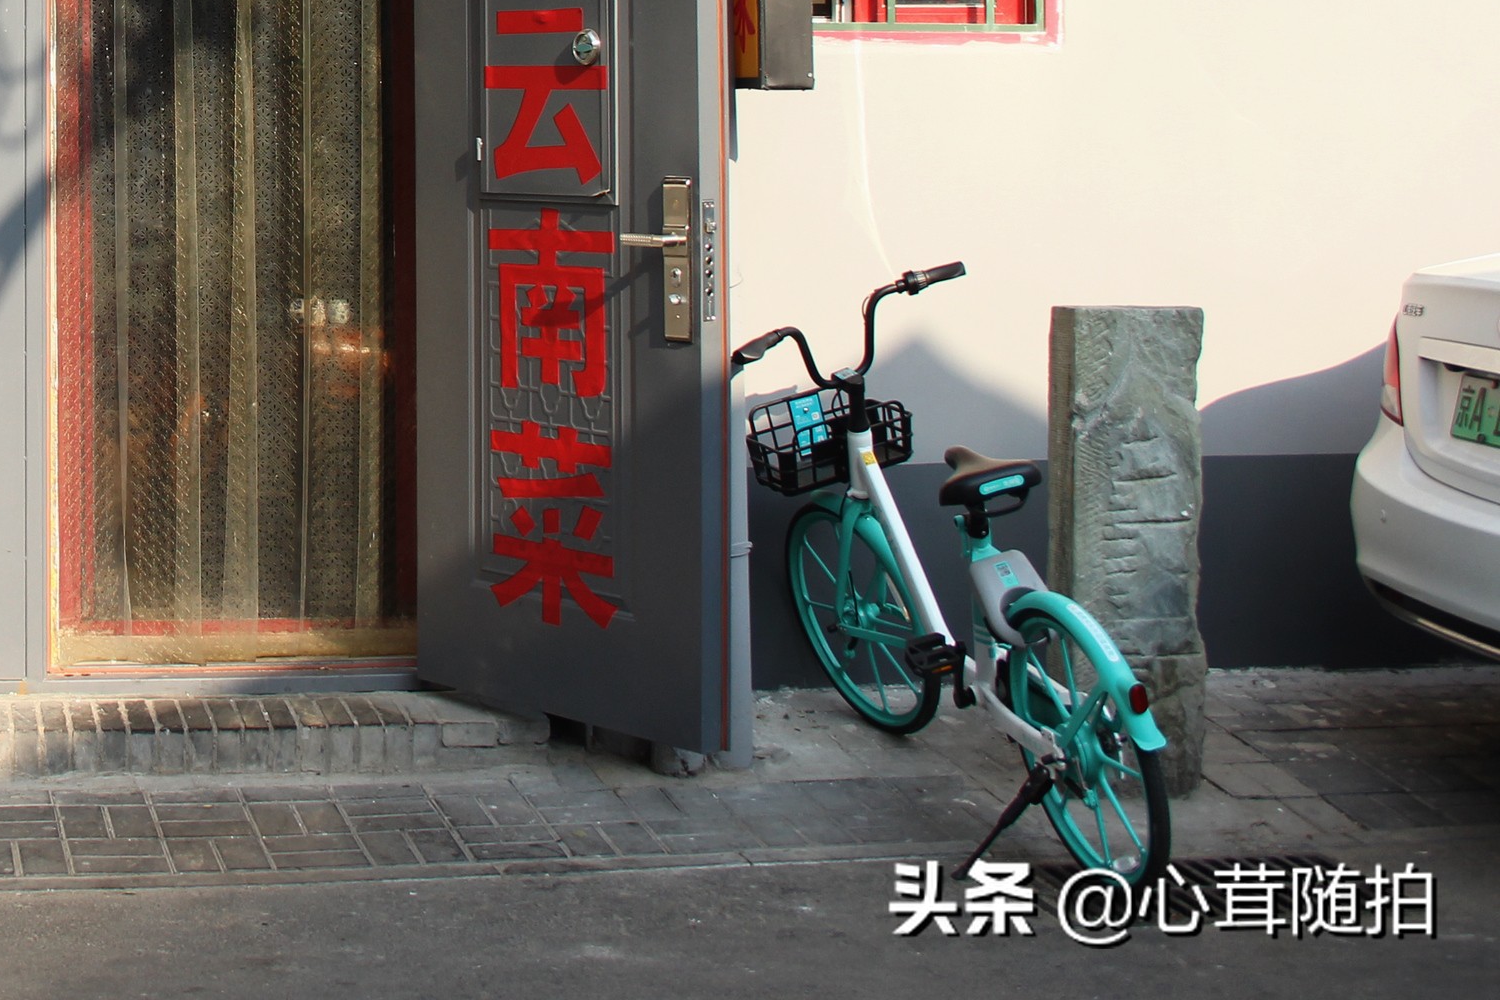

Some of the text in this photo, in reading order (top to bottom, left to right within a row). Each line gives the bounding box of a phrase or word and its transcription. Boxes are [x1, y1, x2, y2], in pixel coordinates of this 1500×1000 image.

[485, 8, 618, 629] 云南菜
[1454, 384, 1500, 437] 京A
